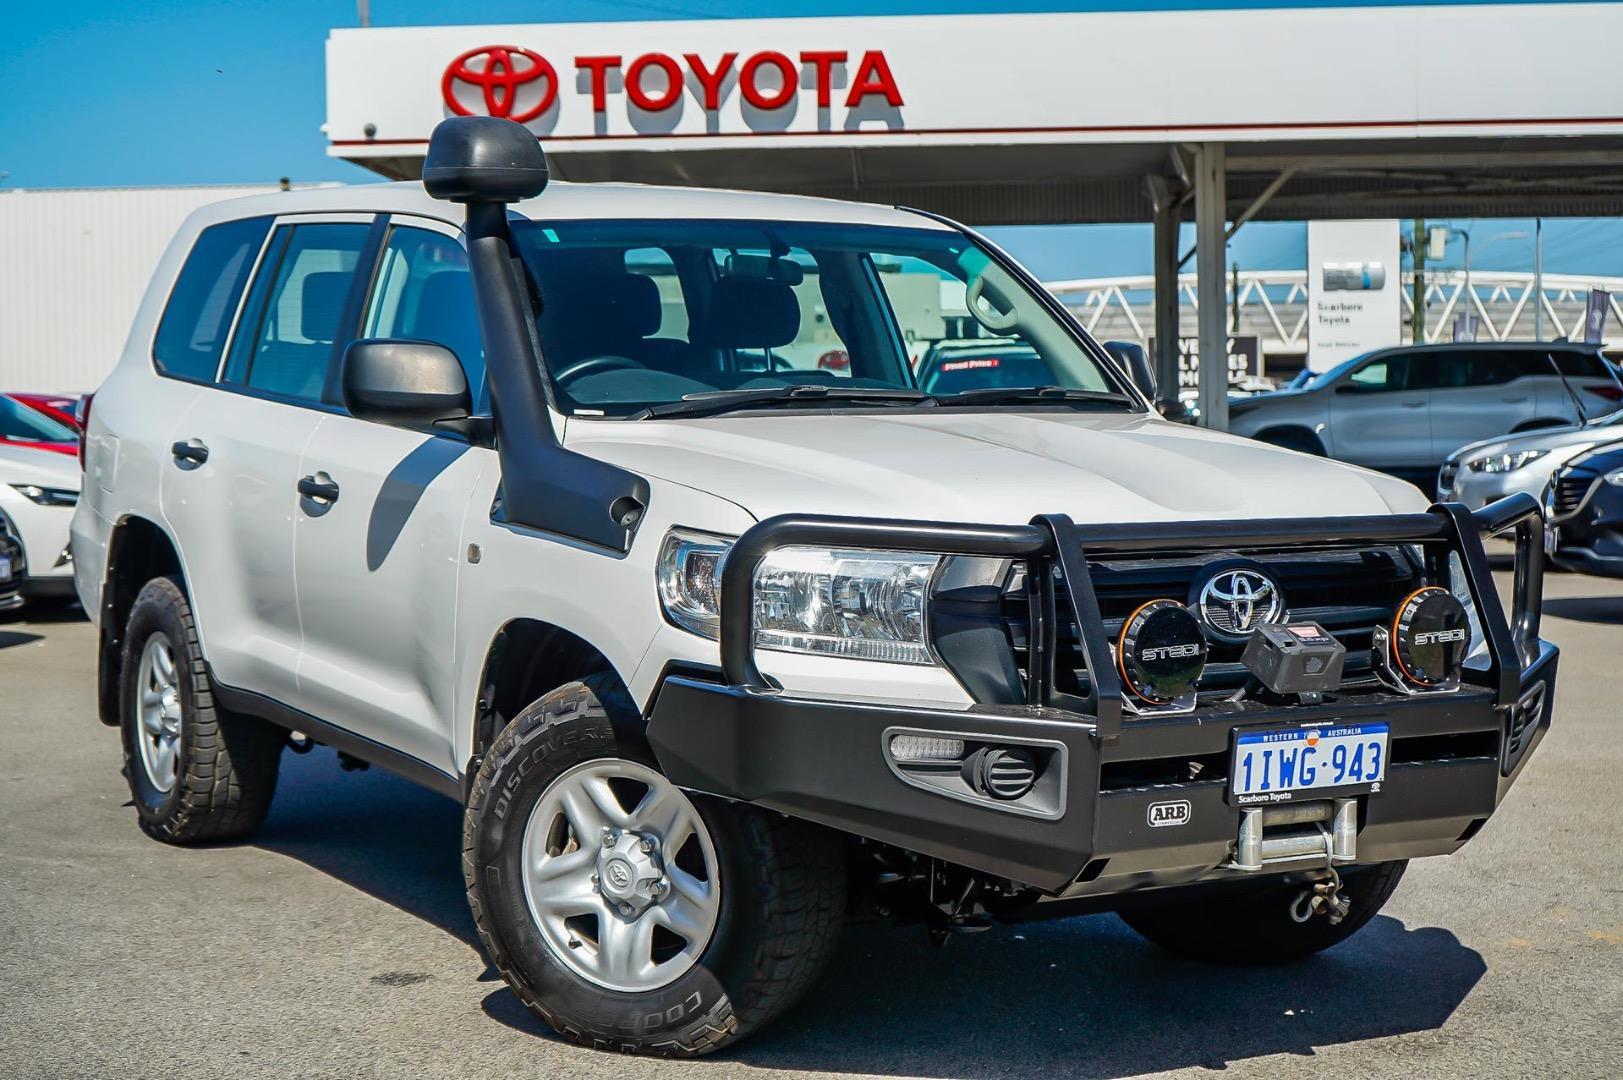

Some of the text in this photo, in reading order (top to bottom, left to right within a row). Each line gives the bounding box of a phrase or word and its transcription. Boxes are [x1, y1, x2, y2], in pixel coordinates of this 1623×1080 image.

[574, 49, 905, 113] TOYOTA
[1319, 315, 1350, 326] Toyota
[1415, 628, 1464, 645] STEDI
[1142, 643, 1199, 661] STEDI
[1263, 727, 1362, 742] WESTERN AUSTRALIA
[494, 726, 614, 820] DISCOVERE
[1238, 792, 1292, 804] Scarboro Toyota
[1153, 805, 1186, 821] ARB
